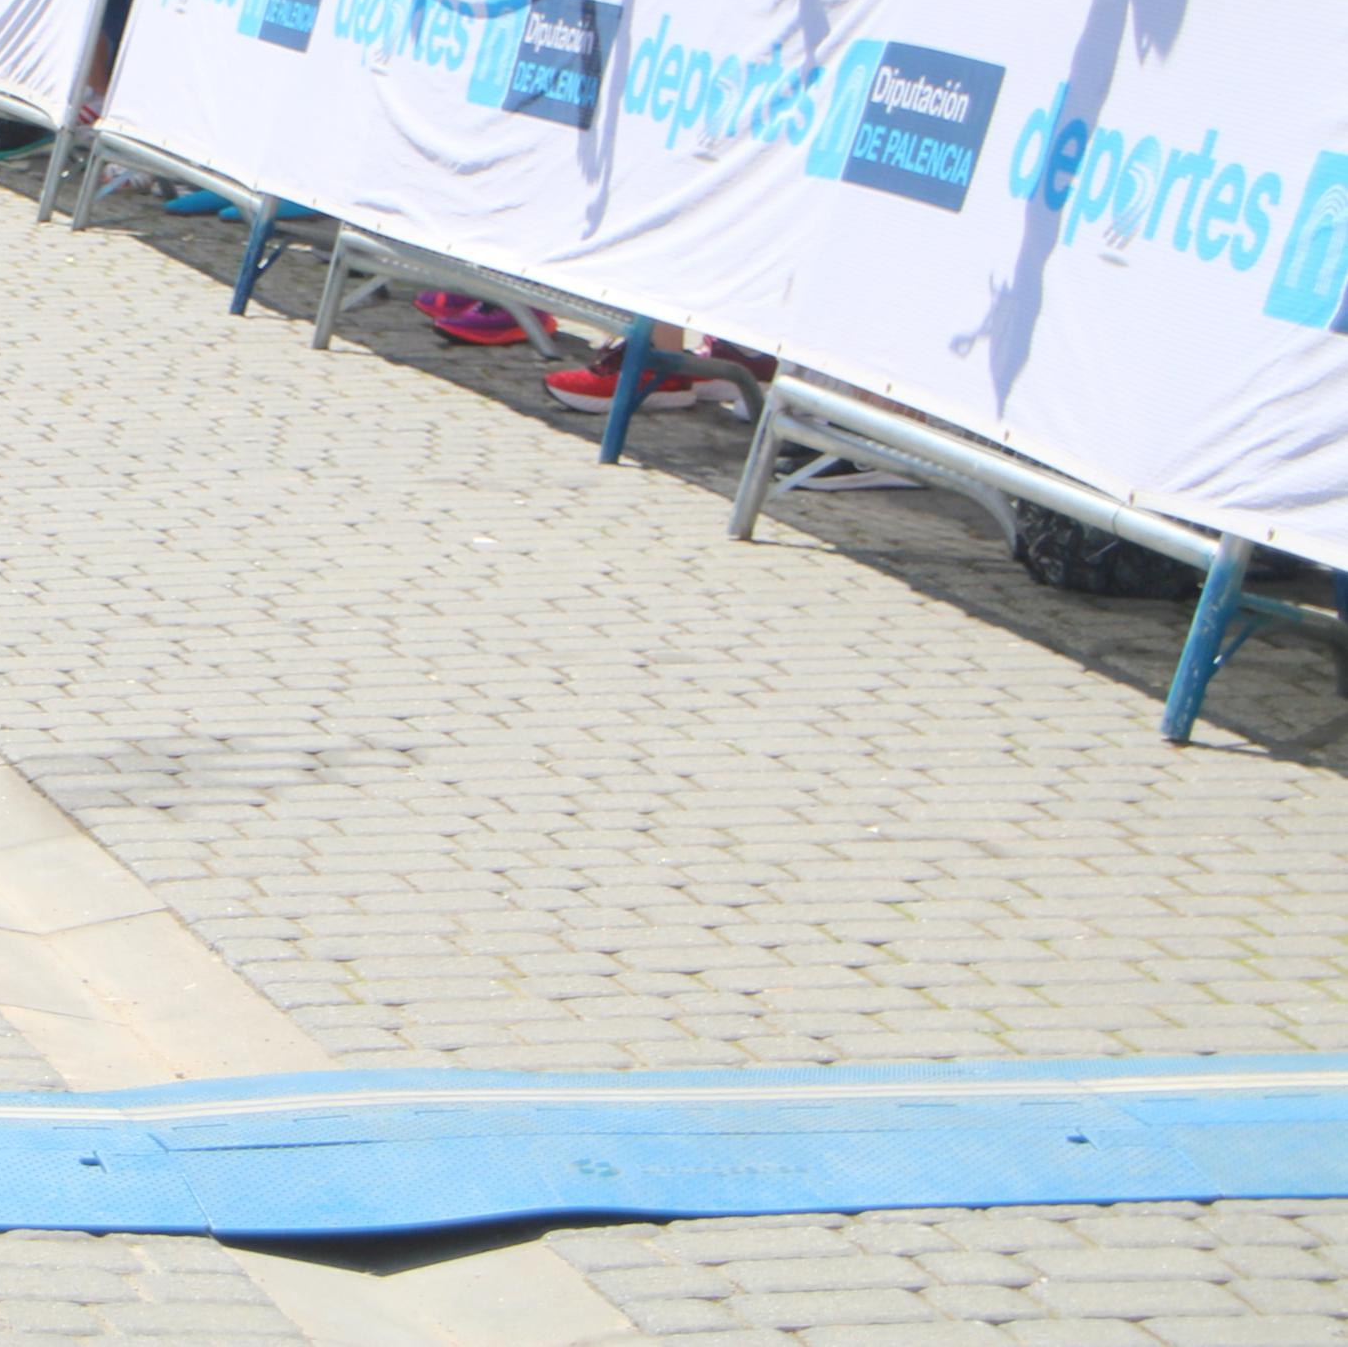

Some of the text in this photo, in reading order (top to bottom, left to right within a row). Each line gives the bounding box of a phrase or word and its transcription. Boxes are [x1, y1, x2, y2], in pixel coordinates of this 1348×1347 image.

[523, 12, 596, 55] Diputación
[512, 60, 533, 93] DE
[622, 13, 827, 151] deportes
[870, 64, 971, 124] Diputación
[852, 122, 976, 188] DE PALENCIA
[1008, 81, 1284, 274] deportes
